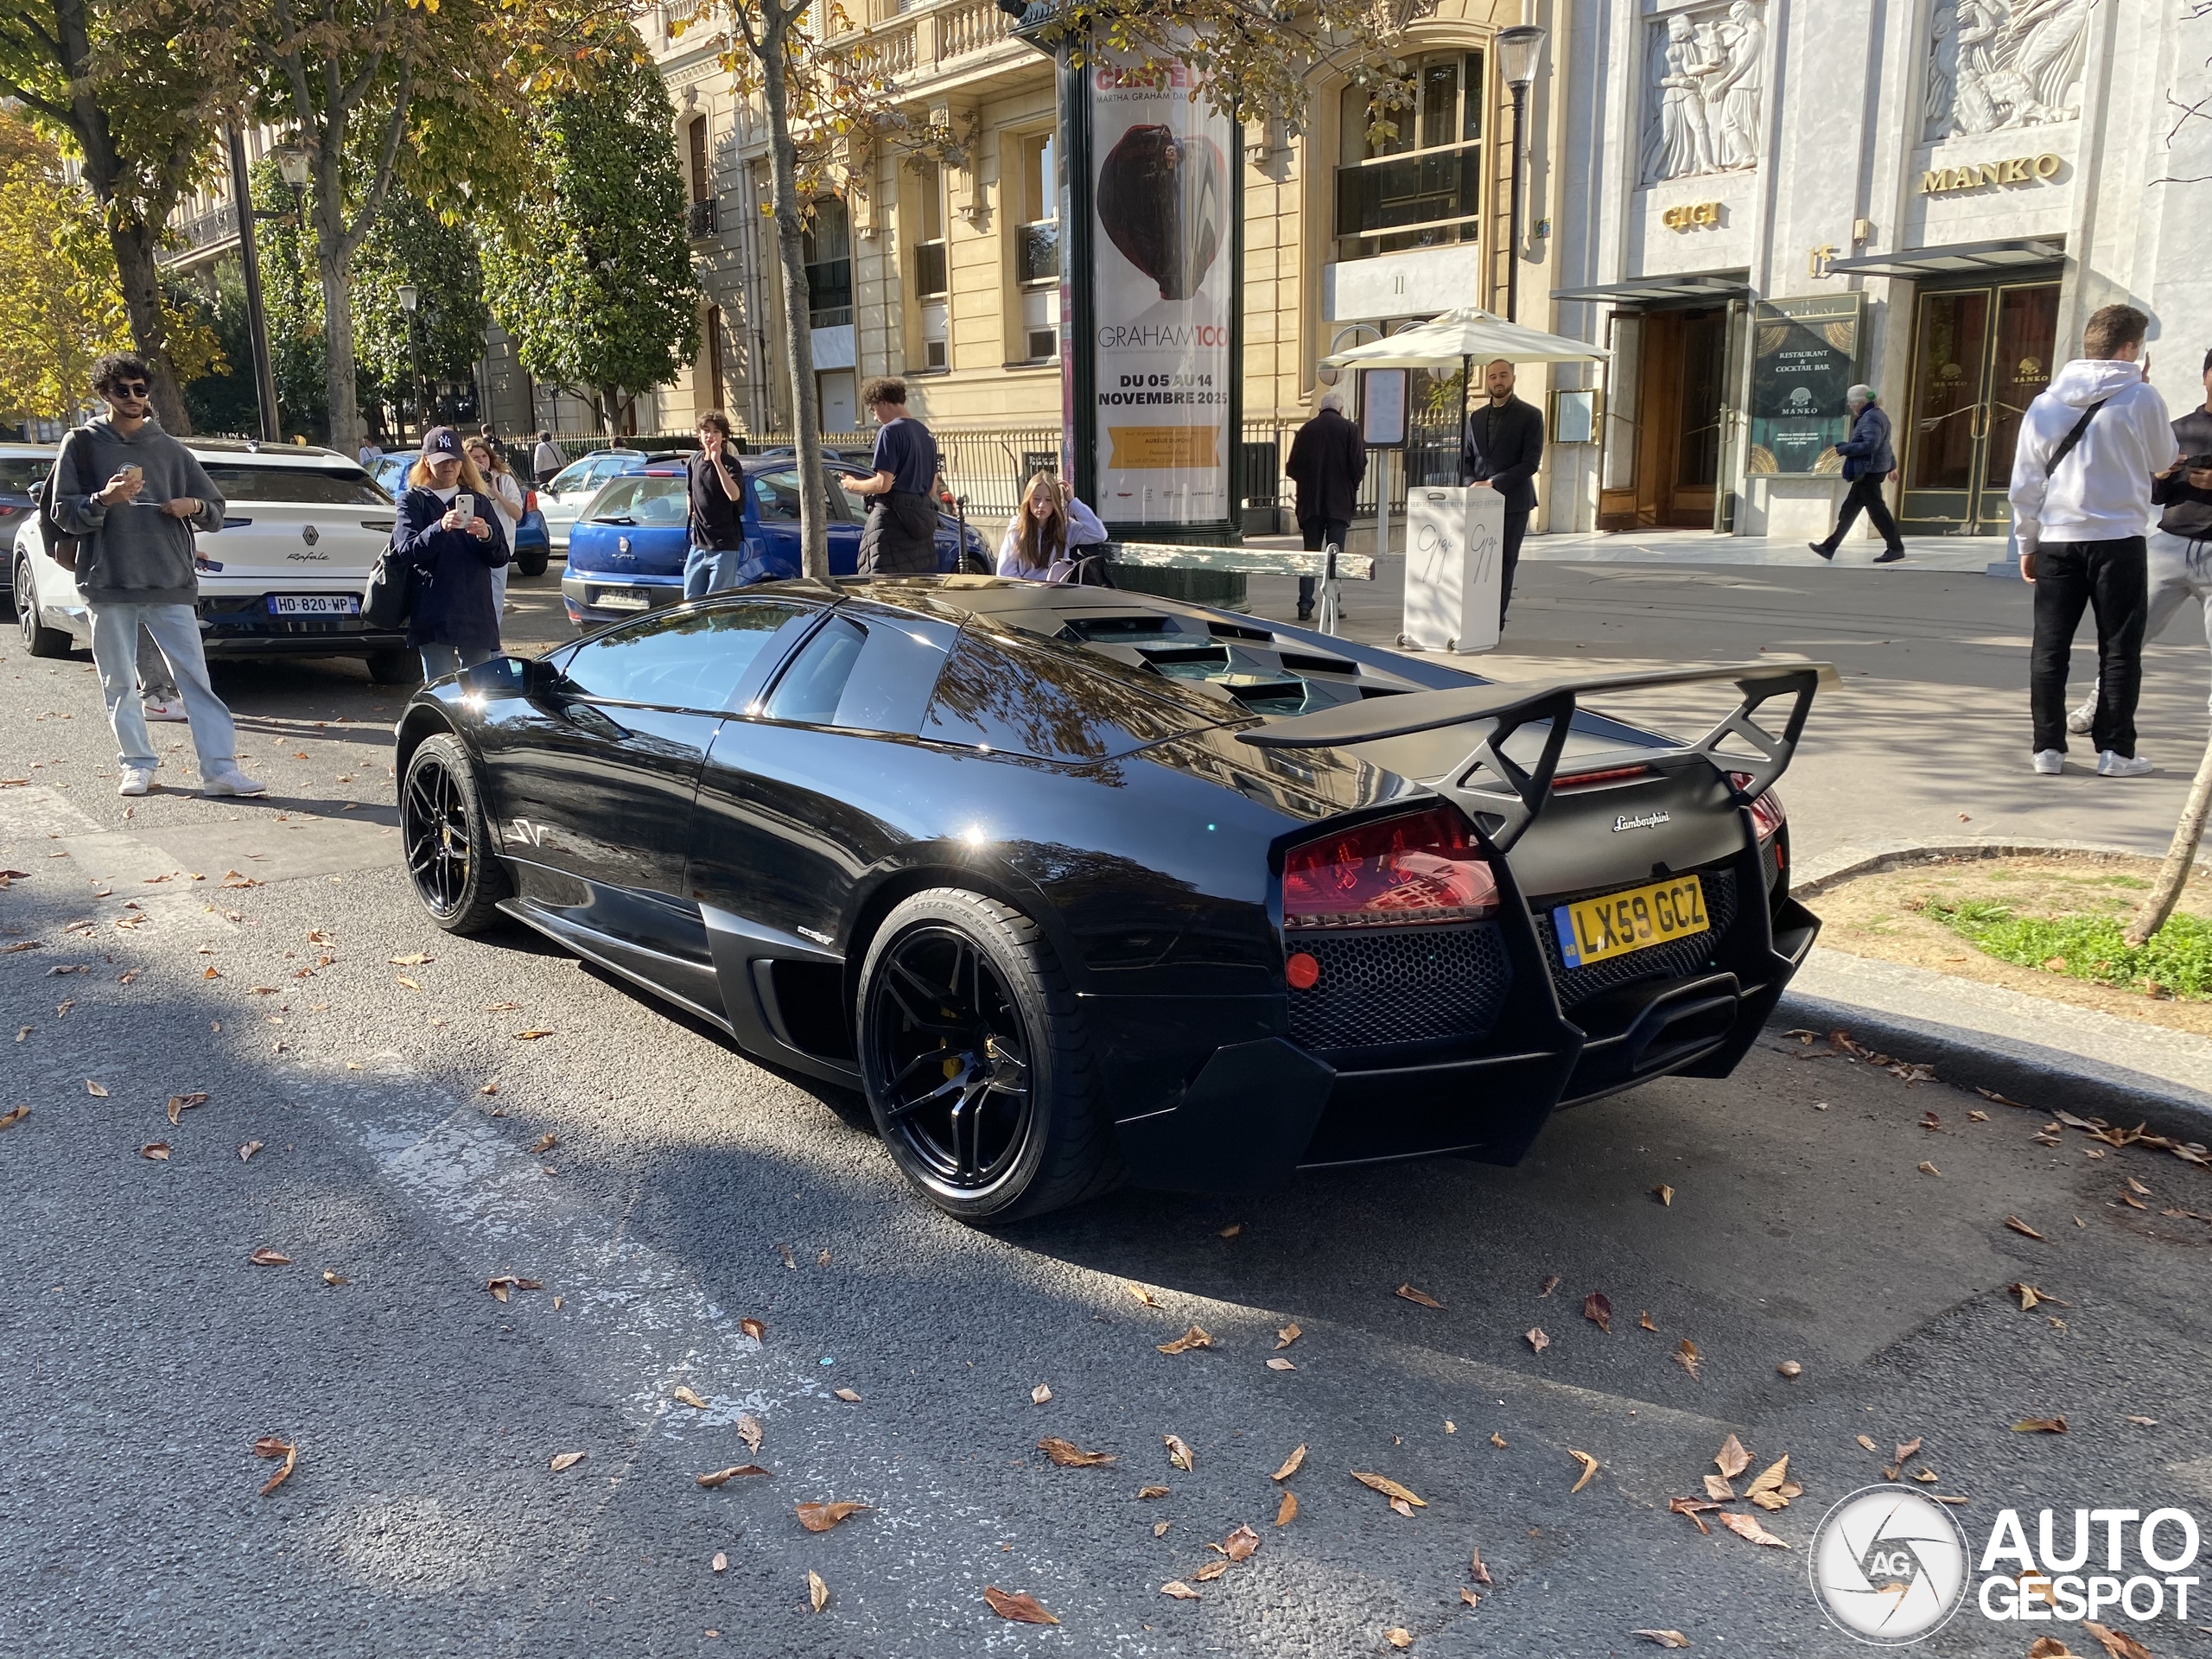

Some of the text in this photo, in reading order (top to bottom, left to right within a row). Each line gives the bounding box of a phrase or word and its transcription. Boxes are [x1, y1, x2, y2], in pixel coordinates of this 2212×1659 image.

[1096, 93, 1129, 104] MARTHA
[1132, 92, 1170, 101] GRAHAM
[1919, 153, 2060, 194] MANKO
[1662, 202, 1720, 228] GIGI
[1779, 350, 1829, 359] RESTAURANT
[1120, 374, 1212, 387] DU 05 AU 14
[1098, 391, 1228, 405] NOVEMBRE 2025
[286, 551, 330, 563] Rafale
[278, 598, 347, 612] HD-820-WP
[1612, 810, 1671, 833] Lamborghini
[1576, 882, 1705, 955] LX59 GCZ
[1564, 944, 1576, 957] GB
